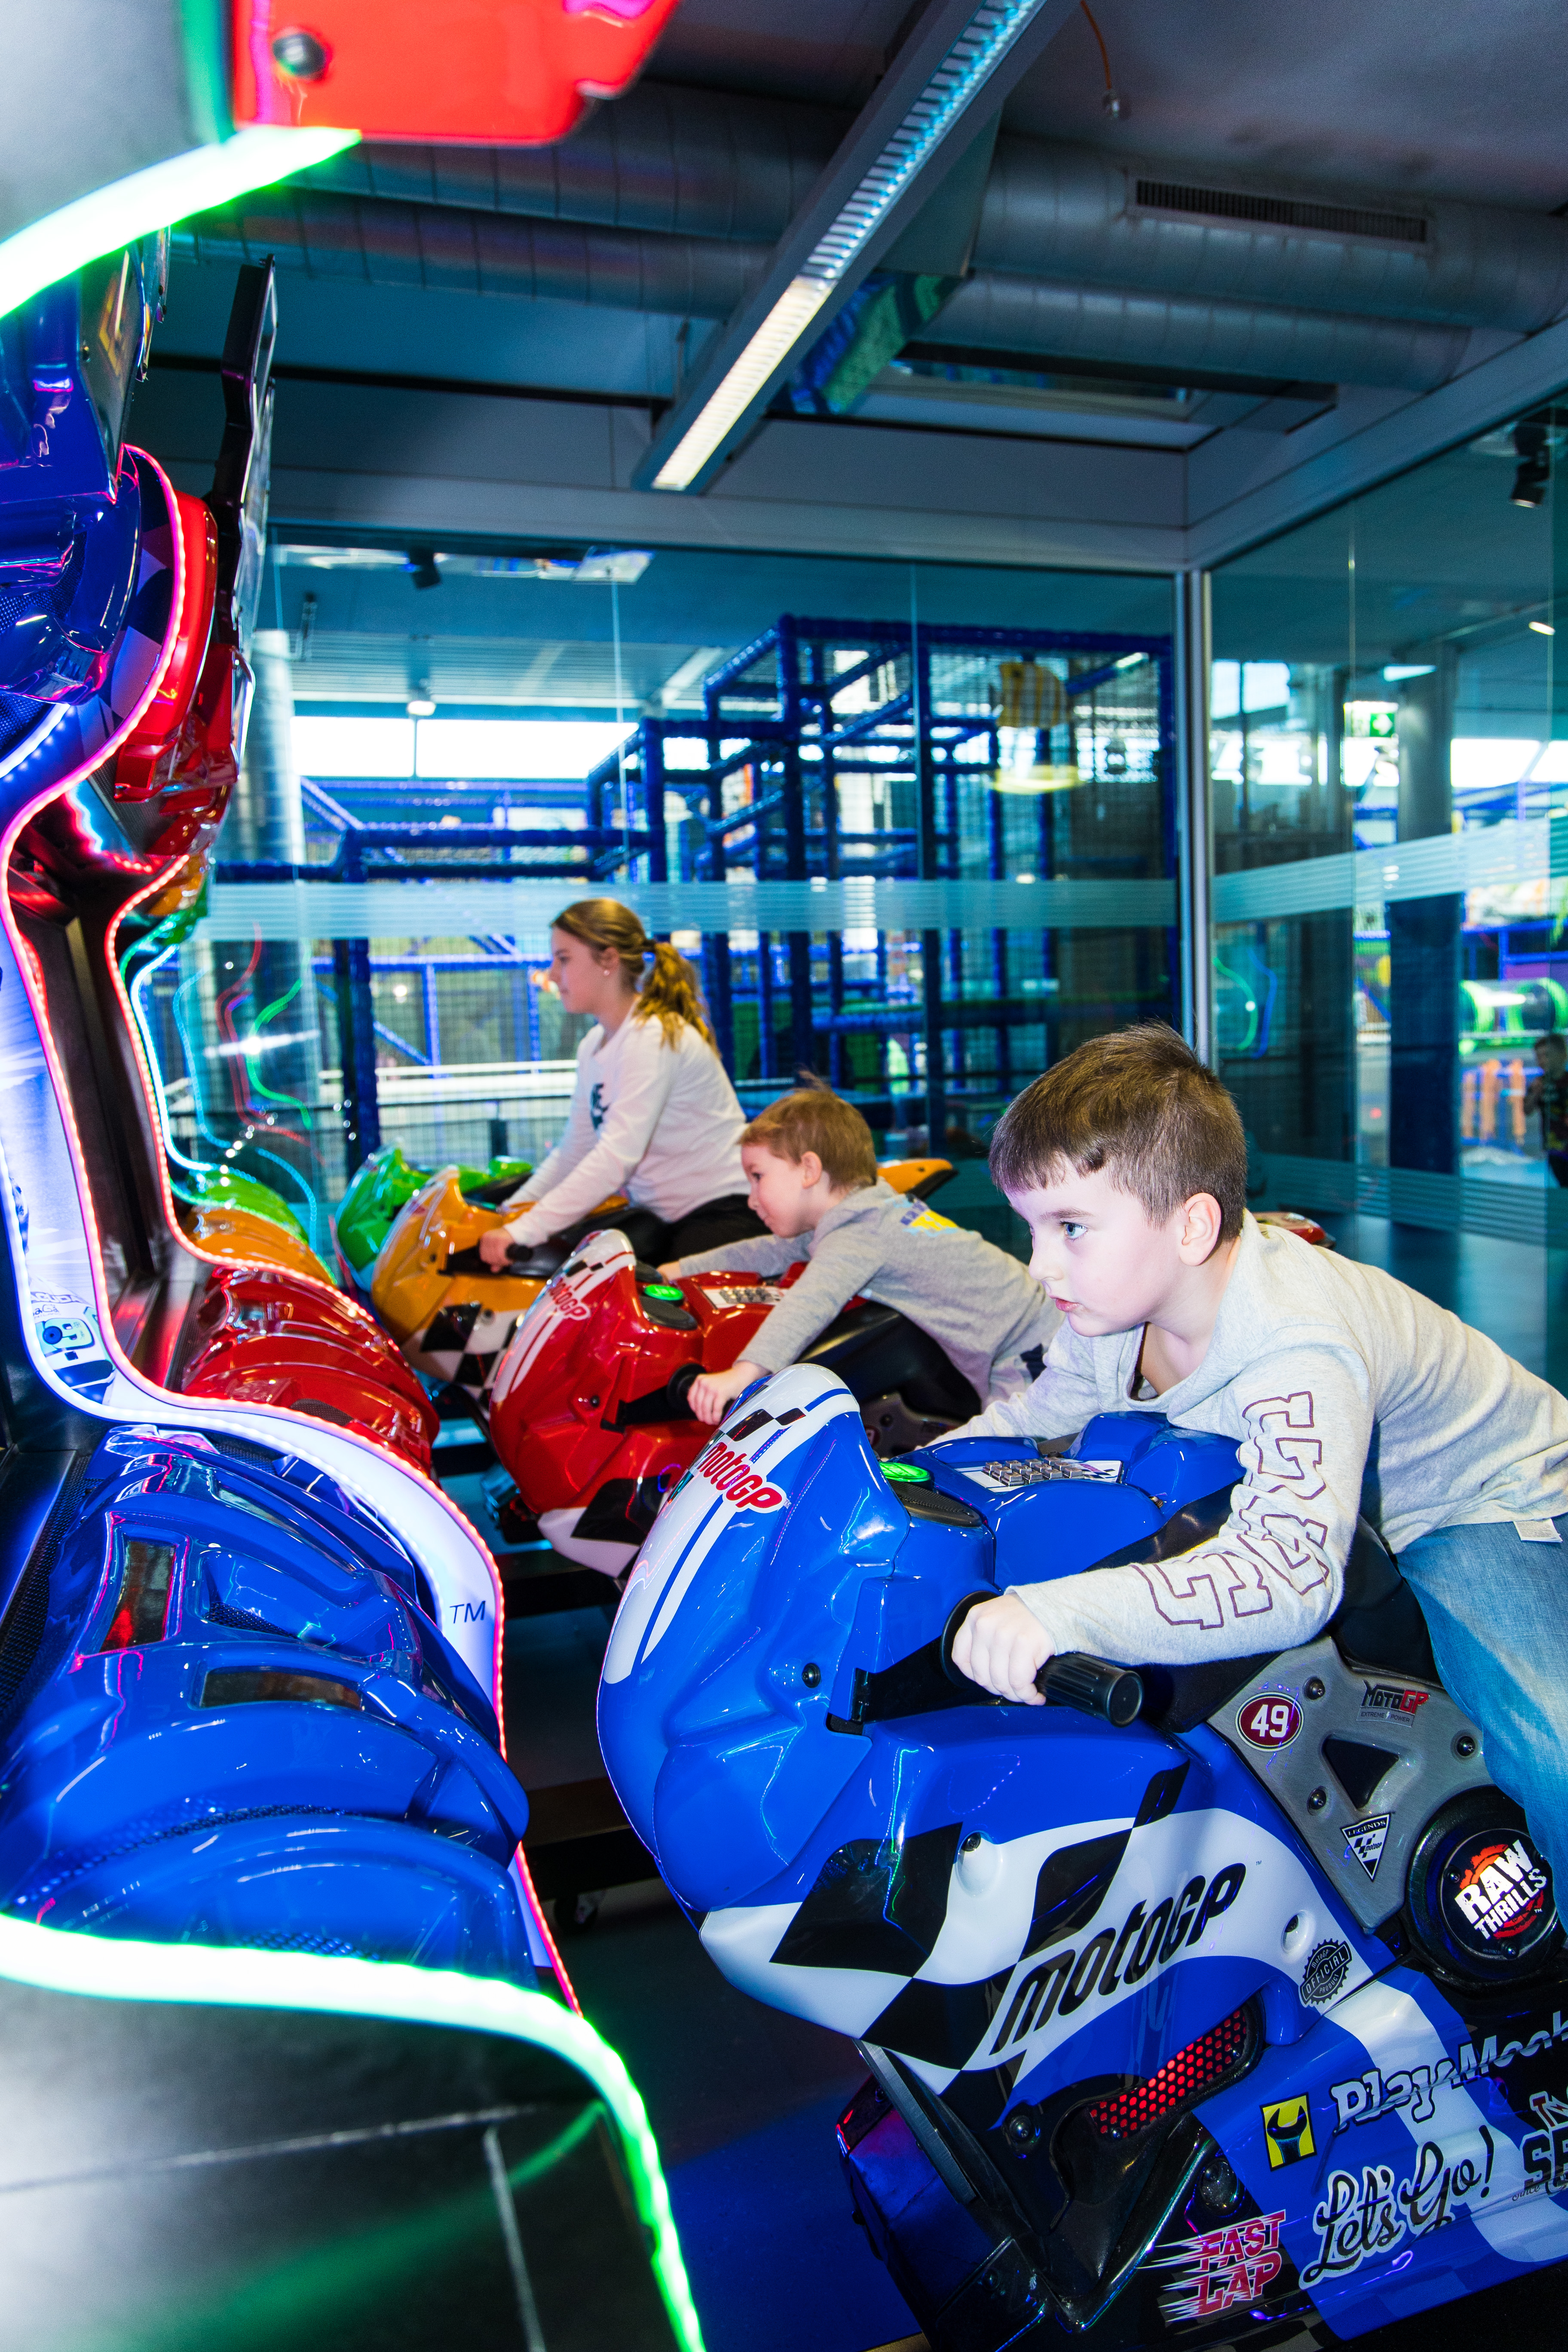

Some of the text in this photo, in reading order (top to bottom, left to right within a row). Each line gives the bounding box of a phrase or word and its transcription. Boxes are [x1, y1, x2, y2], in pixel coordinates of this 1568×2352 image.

[450, 1601, 486, 1624] TM
[1251, 1704, 1289, 1738] 49
[1390, 1714, 1410, 1722] POWER
[1348, 1820, 1386, 1836] LEGENDS
[1455, 1839, 1533, 1925] RAW
[1474, 1868, 1547, 1940] THRILLS
[989, 1862, 1246, 2055] motoGP
[1306, 1951, 1345, 1994] OFFICIAL
[1319, 1973, 1339, 1994] PRODUCT
[1161, 2209, 1286, 2272] FAST
[1303, 2169, 1403, 2283] Let's
[1171, 2251, 1282, 2317] LAP
